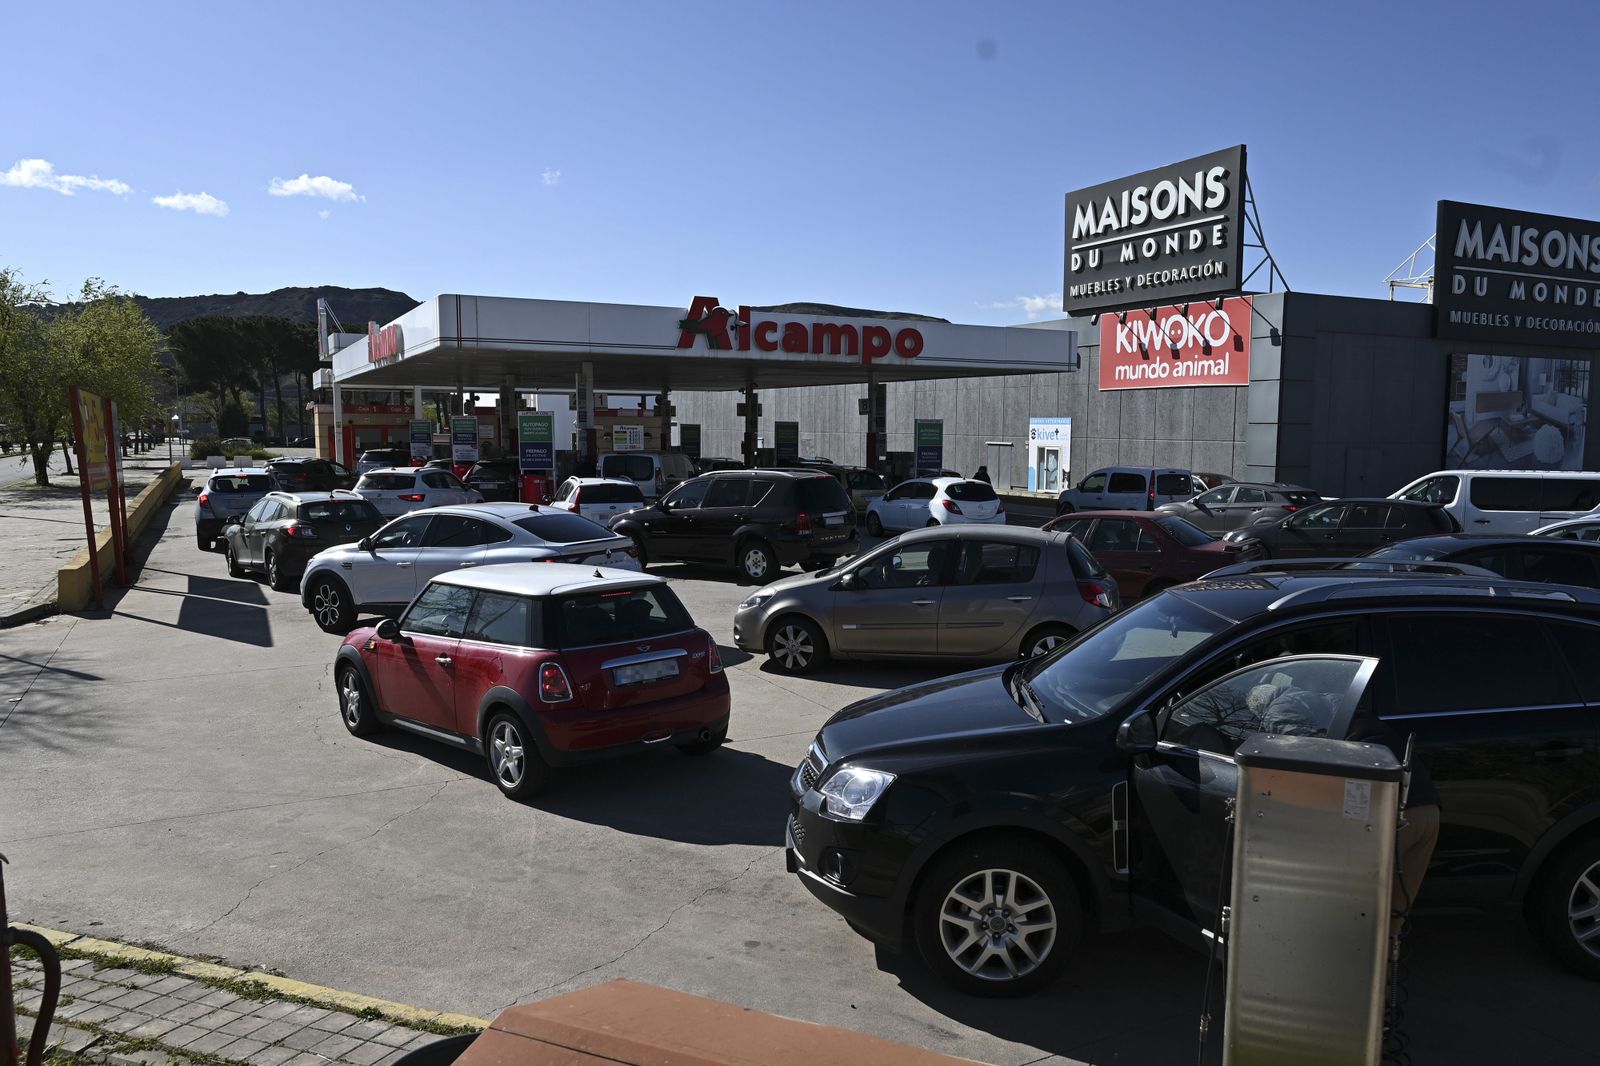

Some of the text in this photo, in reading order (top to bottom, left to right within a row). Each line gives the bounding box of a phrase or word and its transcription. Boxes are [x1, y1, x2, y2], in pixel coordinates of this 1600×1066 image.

[1072, 166, 1227, 240] MAISONS
[1070, 224, 1225, 272] DU MONDE
[1069, 259, 1224, 297] MUEBLES Y DECORACIÓN
[1451, 274, 1600, 308] DU MONDE
[677, 295, 924, 365] Alcampo
[1115, 309, 1231, 354] KIWOKO
[1450, 310, 1509, 327] MUEBLES
[1513, 316, 1522, 328] Y
[1115, 352, 1230, 380] mundo animal
[1037, 428, 1059, 441] kivet
